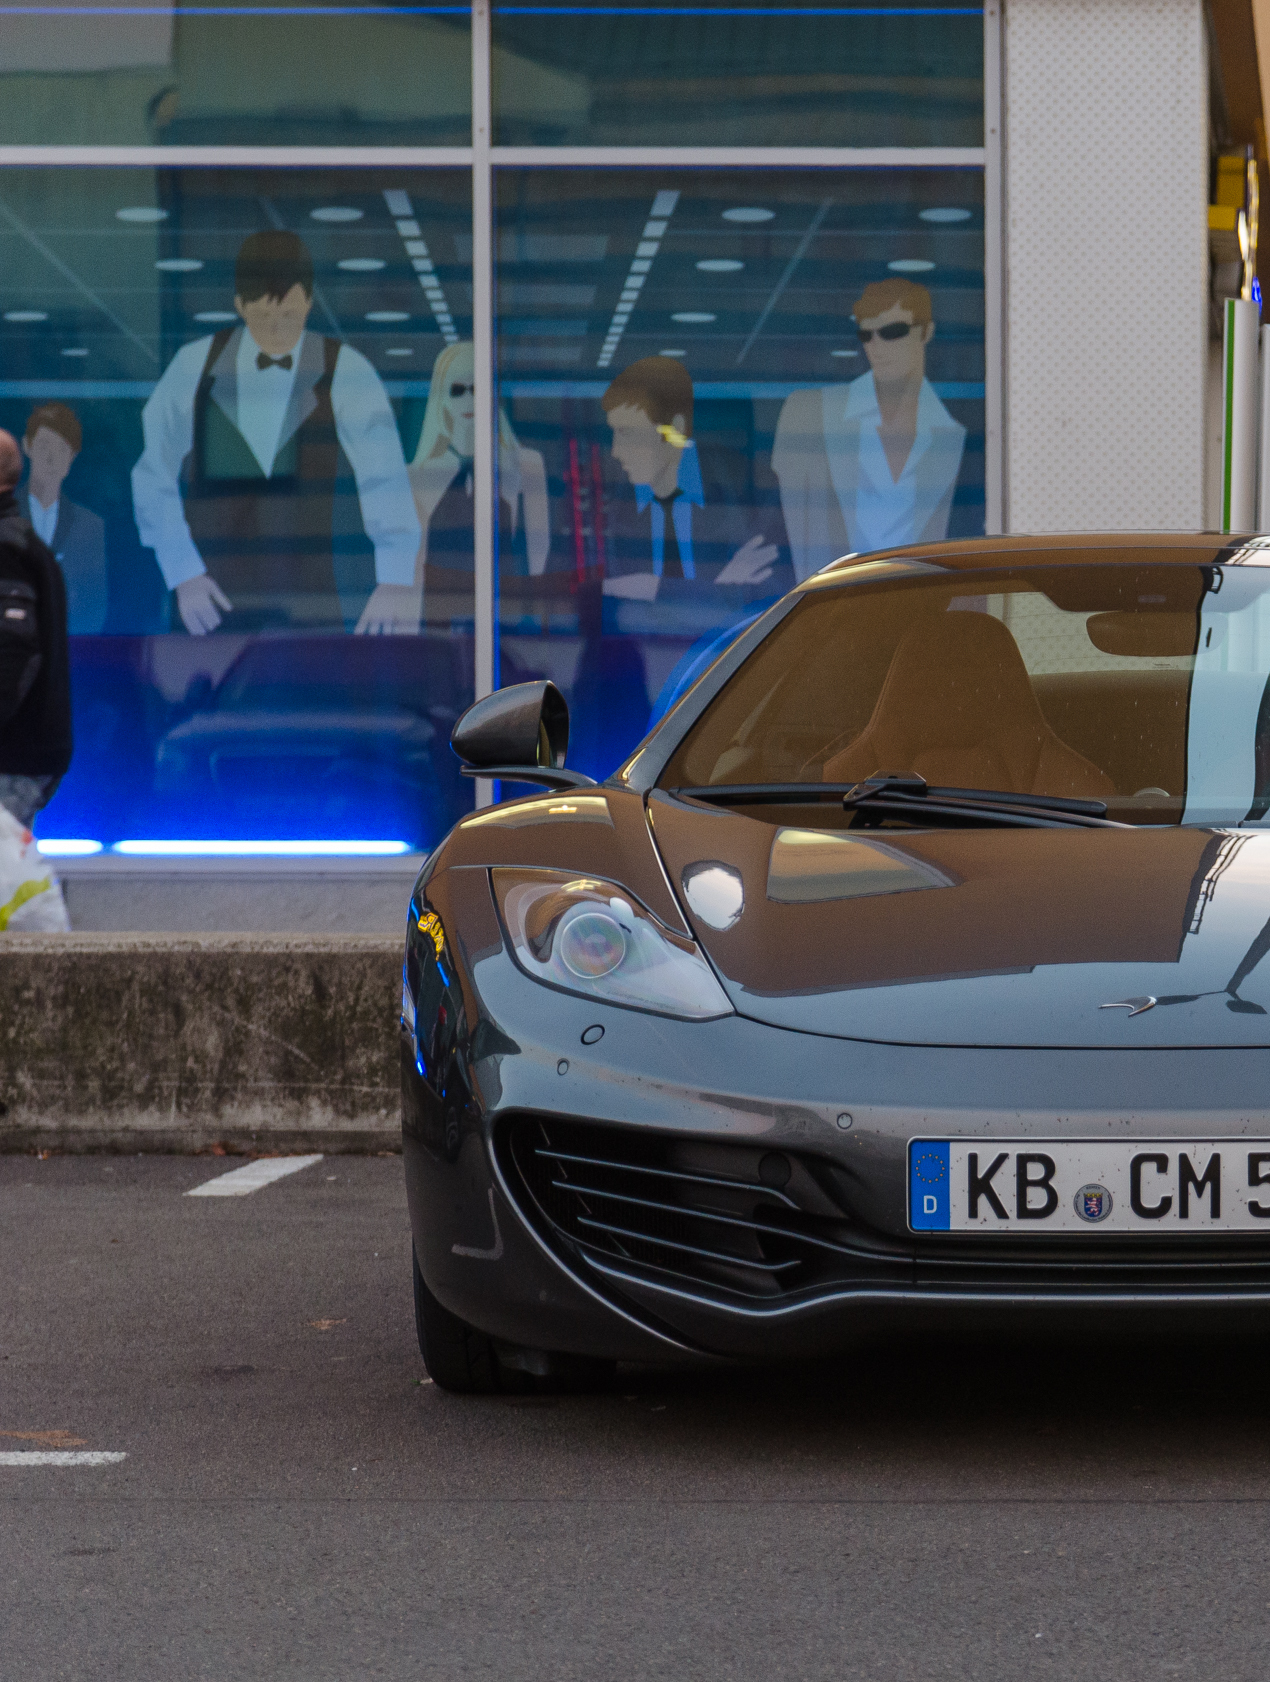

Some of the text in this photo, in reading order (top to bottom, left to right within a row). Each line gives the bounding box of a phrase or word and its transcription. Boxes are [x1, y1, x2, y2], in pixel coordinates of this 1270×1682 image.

[923, 1195, 938, 1214] D
[967, 1152, 1059, 1220] KB
[1129, 1152, 1221, 1220] CM
